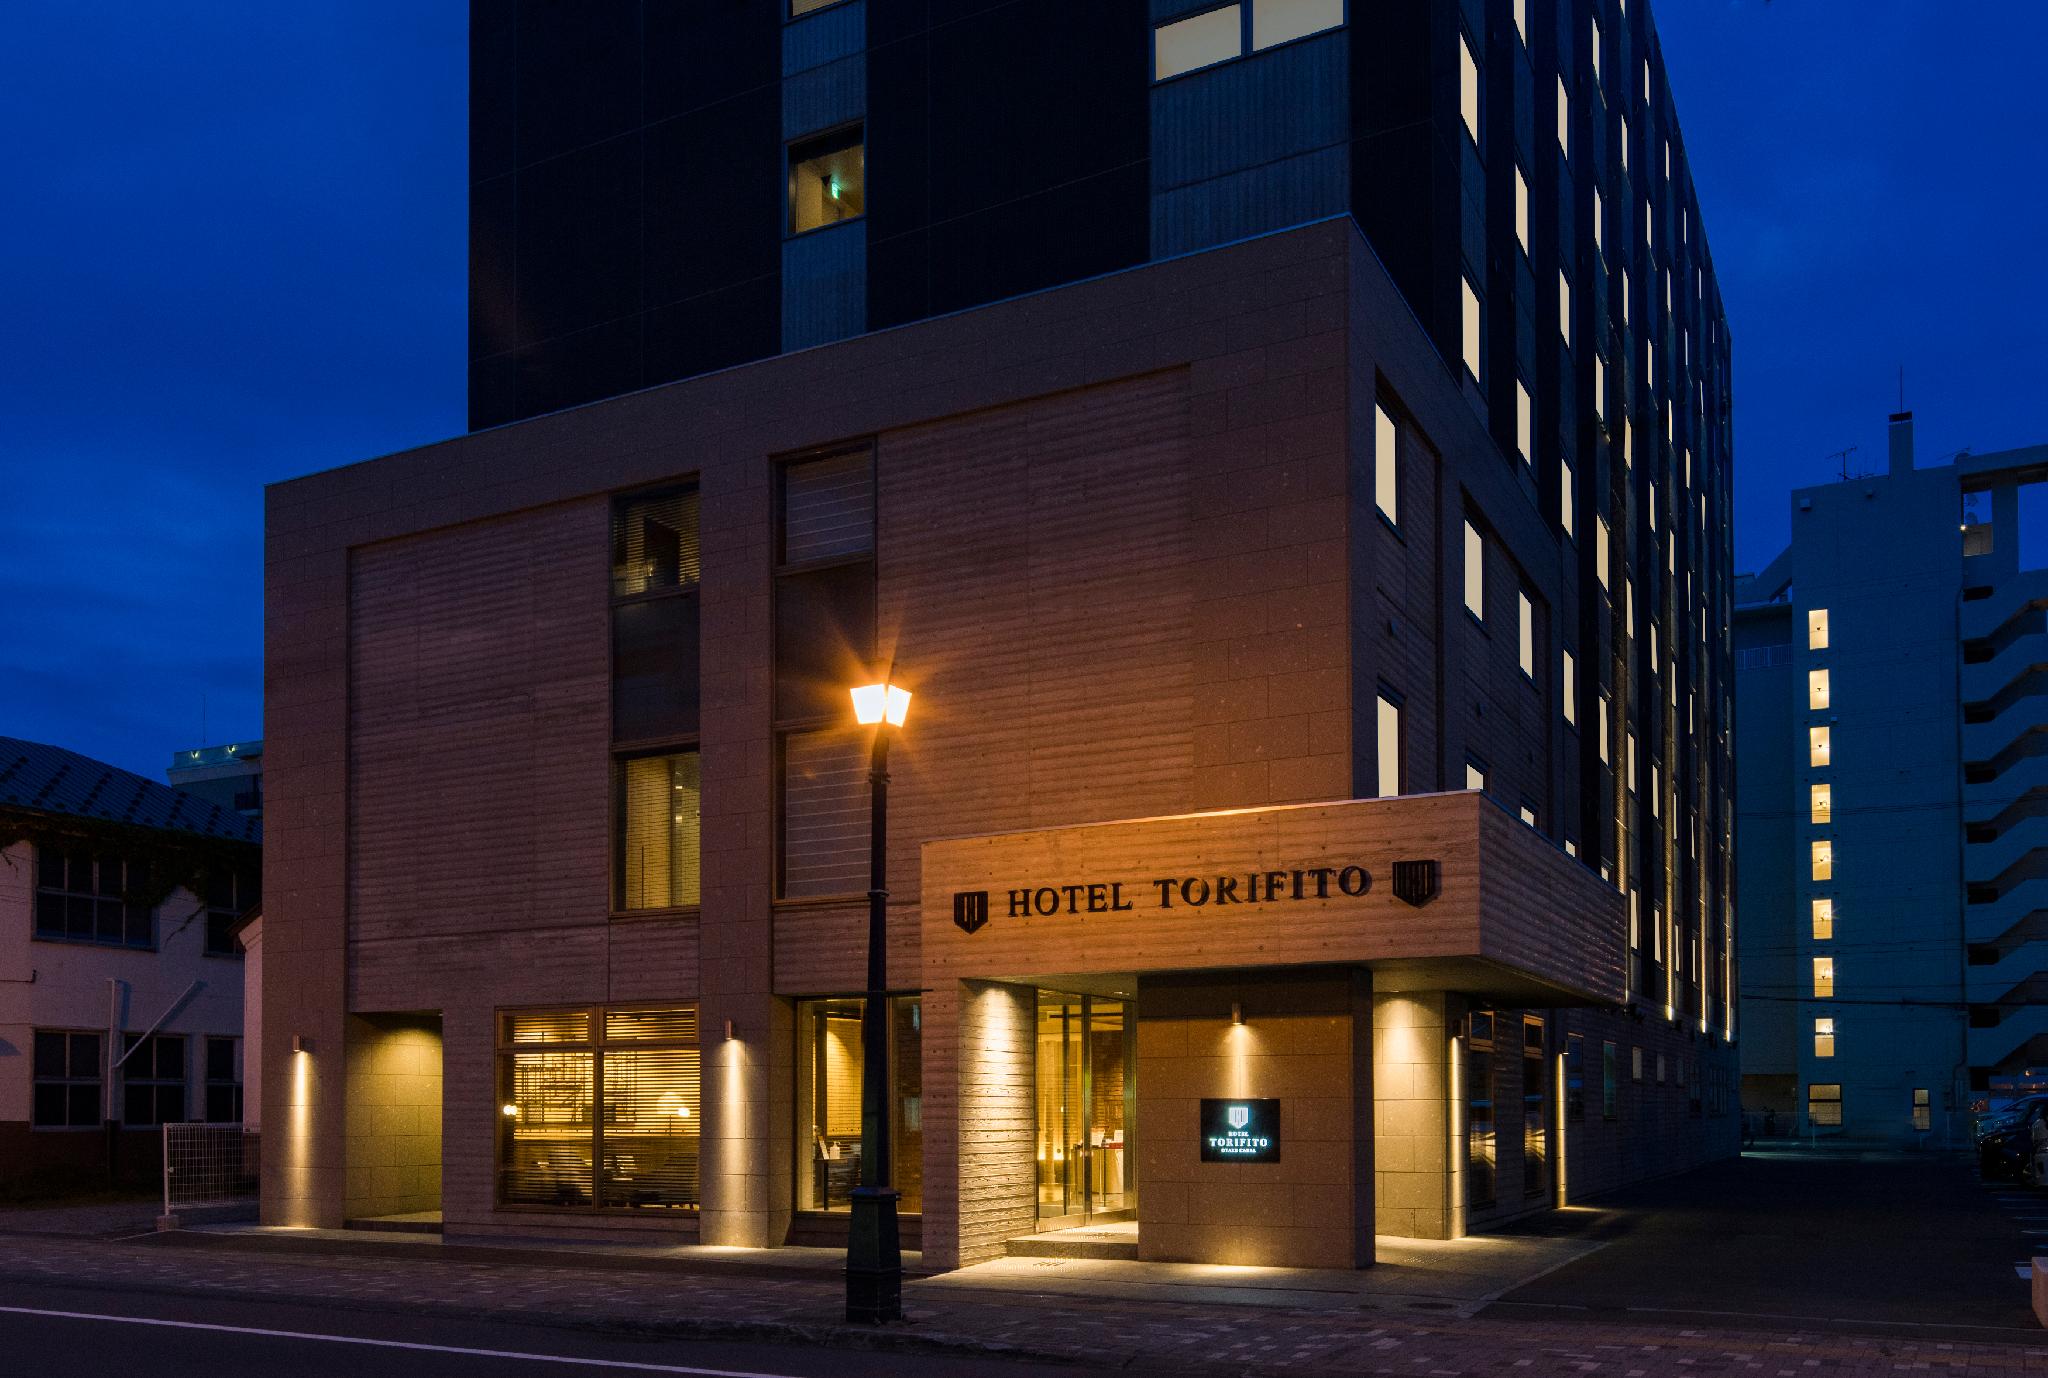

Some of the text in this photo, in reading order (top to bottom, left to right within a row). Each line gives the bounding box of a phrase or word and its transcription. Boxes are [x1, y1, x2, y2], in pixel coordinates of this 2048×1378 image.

[1007, 865, 1373, 918] HOTEL TORIFITO
[1209, 1138, 1268, 1147] TORIFITO
